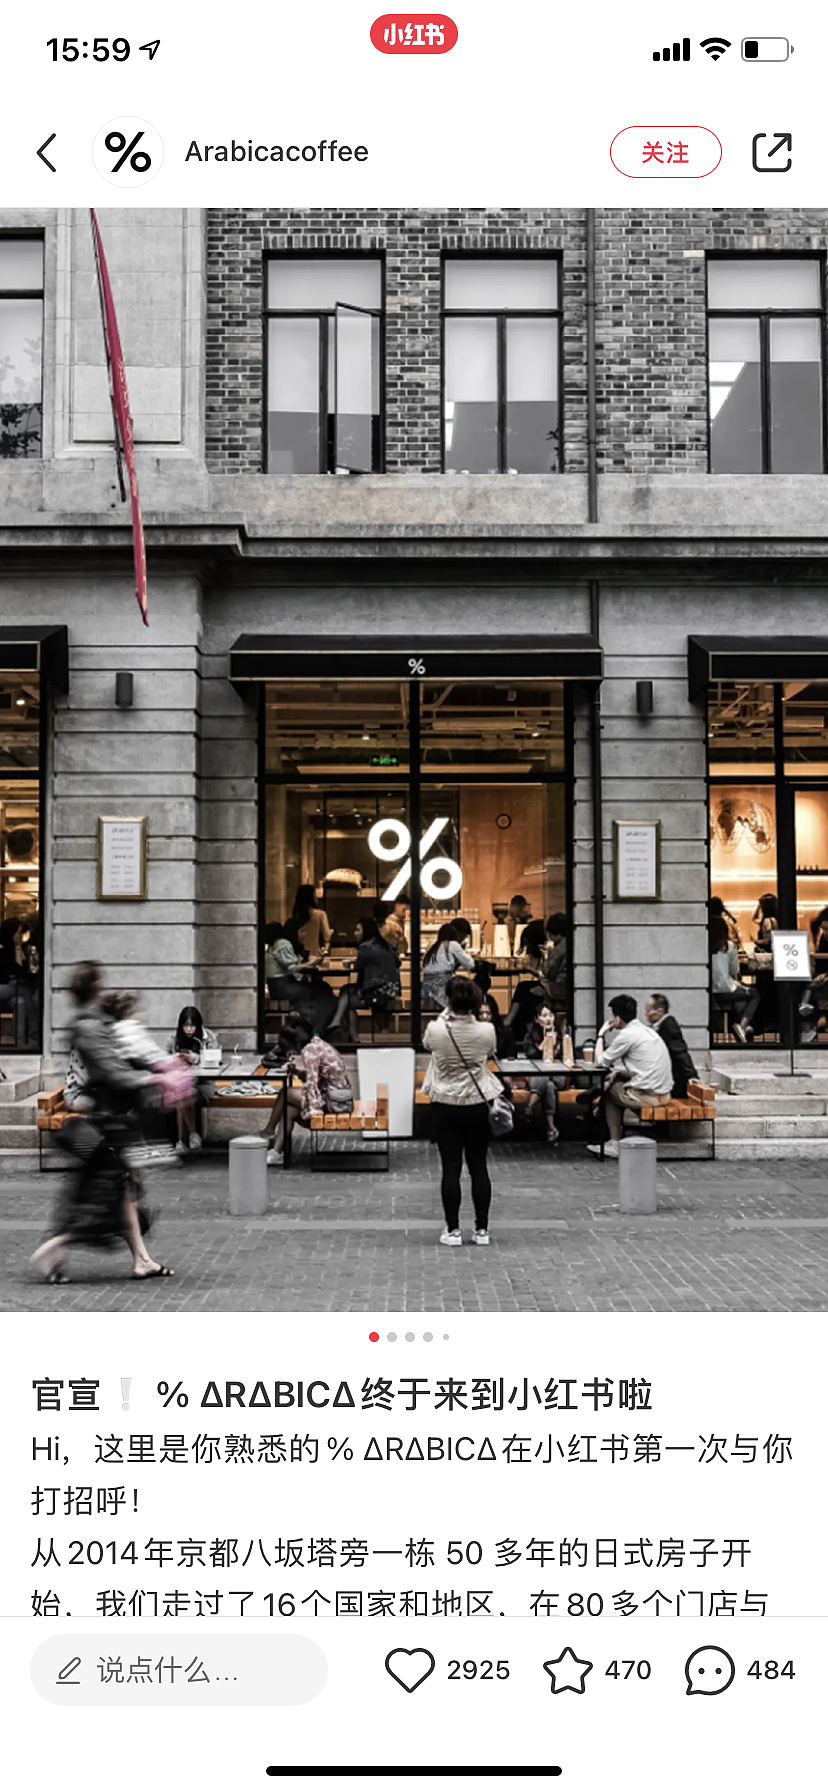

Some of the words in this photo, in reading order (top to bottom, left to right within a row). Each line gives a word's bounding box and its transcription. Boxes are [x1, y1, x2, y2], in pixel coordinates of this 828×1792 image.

[383, 22, 445, 46] 小红书
[46, 37, 131, 63] 15:59
[184, 139, 369, 162] Arabicacoffee
[641, 140, 690, 165] 关注
[367, 817, 463, 901] %
[447, 1659, 511, 1681] 2925
[604, 1659, 652, 1681] 470
[746, 1659, 796, 1680] 484
